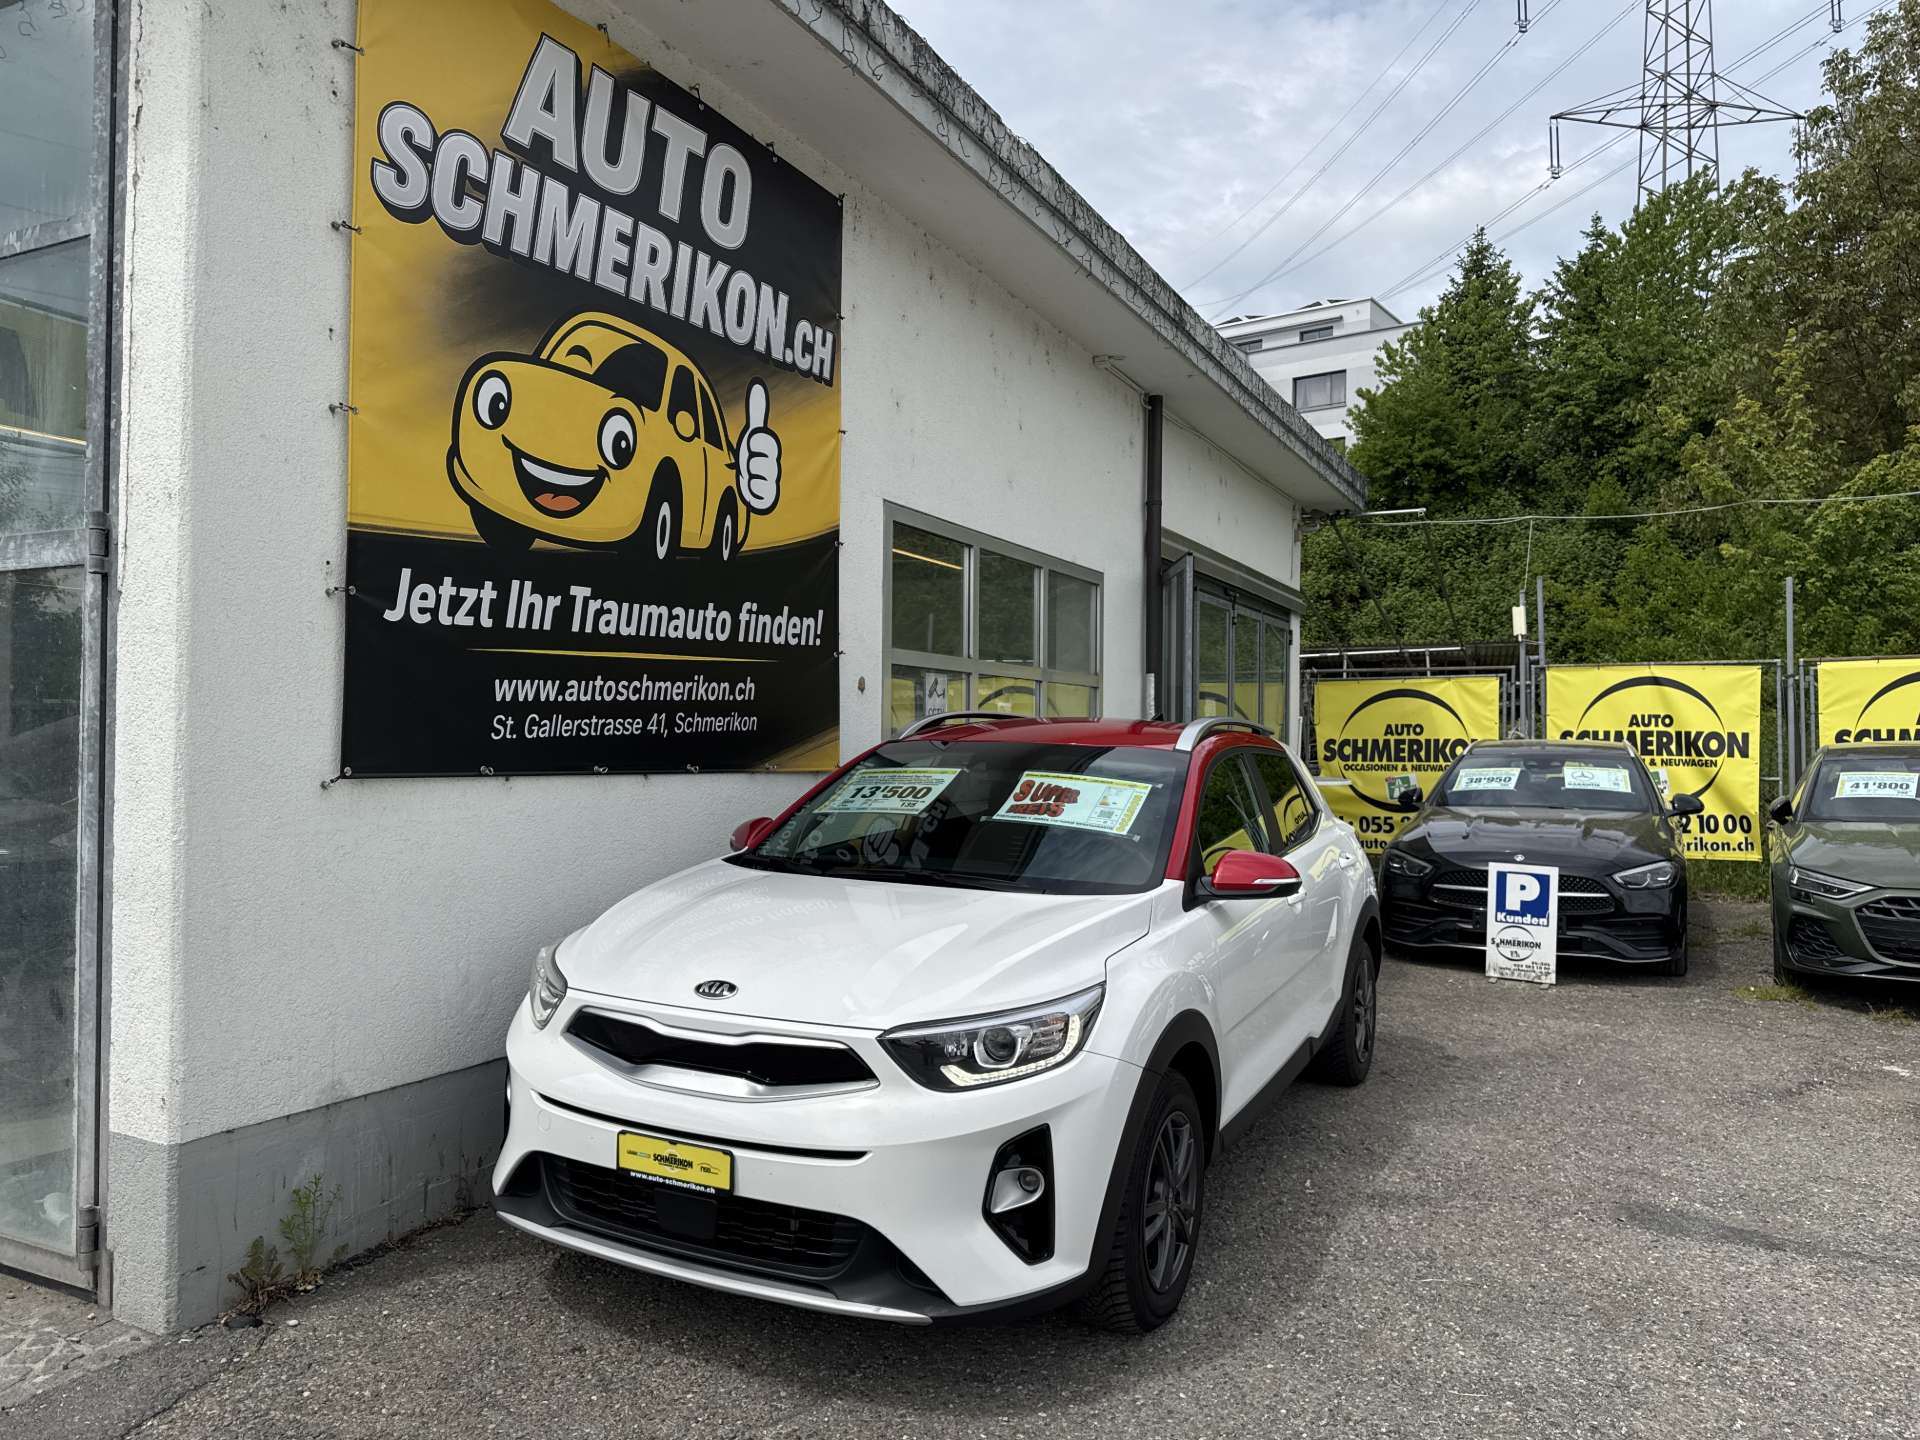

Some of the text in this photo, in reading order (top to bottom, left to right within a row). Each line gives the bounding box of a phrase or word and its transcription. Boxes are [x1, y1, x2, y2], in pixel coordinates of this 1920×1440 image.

[503, 32, 753, 250] AUTO
[371, 101, 836, 385] SCHMERIKON.CH
[383, 568, 824, 647] Jetzt Ihr Traumauto finden!
[494, 674, 756, 703] www.autoschmerikon.ch
[490, 711, 758, 741] St. Gallerstrasse 41, Schmerikon
[1628, 713, 1674, 728] AUTO
[1384, 723, 1424, 737] AUTO
[1323, 738, 1478, 763] SCHMERIKO
[1343, 763, 1398, 772] OCCASIONEN
[1400, 763, 1408, 772] &
[1649, 759, 1657, 767] &
[1661, 759, 1718, 768] NEUWAGEN
[1465, 777, 1512, 785] 38'950
[1850, 782, 1910, 790] 41'800
[849, 785, 932, 799] 13'500
[1359, 816, 1395, 834] 055
[1505, 872, 1541, 911] P
[1496, 911, 1550, 926] Kunden
[1491, 937, 1541, 949] SHMERIKON
[699, 981, 730, 995] KIA
[653, 1153, 694, 1169] SCHMERIKON
[630, 1171, 716, 1194] www.auto-schmerikon.ch
